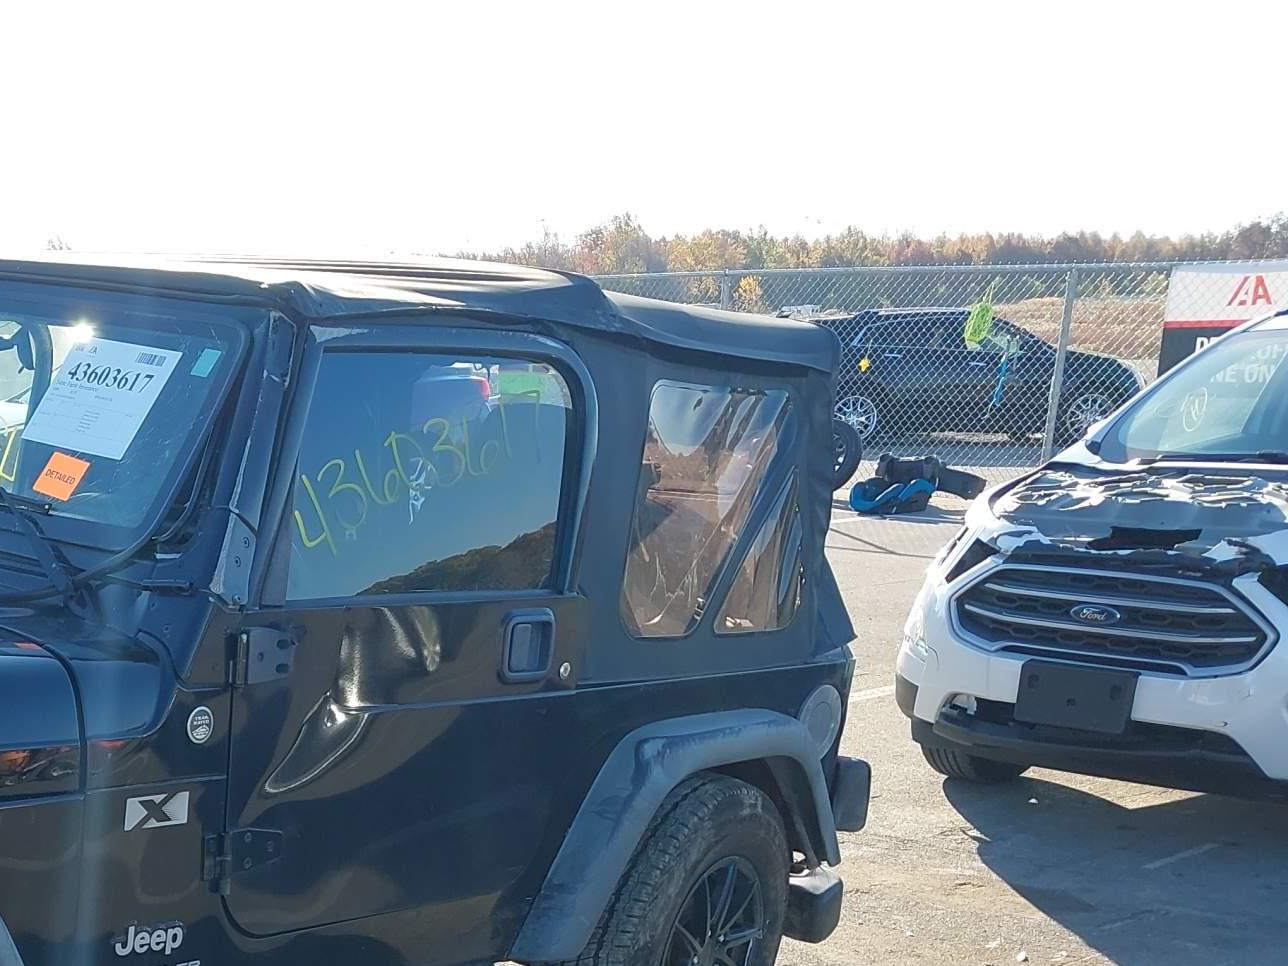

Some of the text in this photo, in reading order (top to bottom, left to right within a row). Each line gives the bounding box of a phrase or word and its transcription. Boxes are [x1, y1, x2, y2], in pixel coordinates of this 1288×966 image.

[67, 361, 156, 393] 43603617
[45, 469, 76, 485] DETAILED
[294, 390, 542, 557] 43603617
[1079, 607, 1108, 621] Ford
[126, 792, 186, 831] X
[114, 923, 185, 957] Jeep
